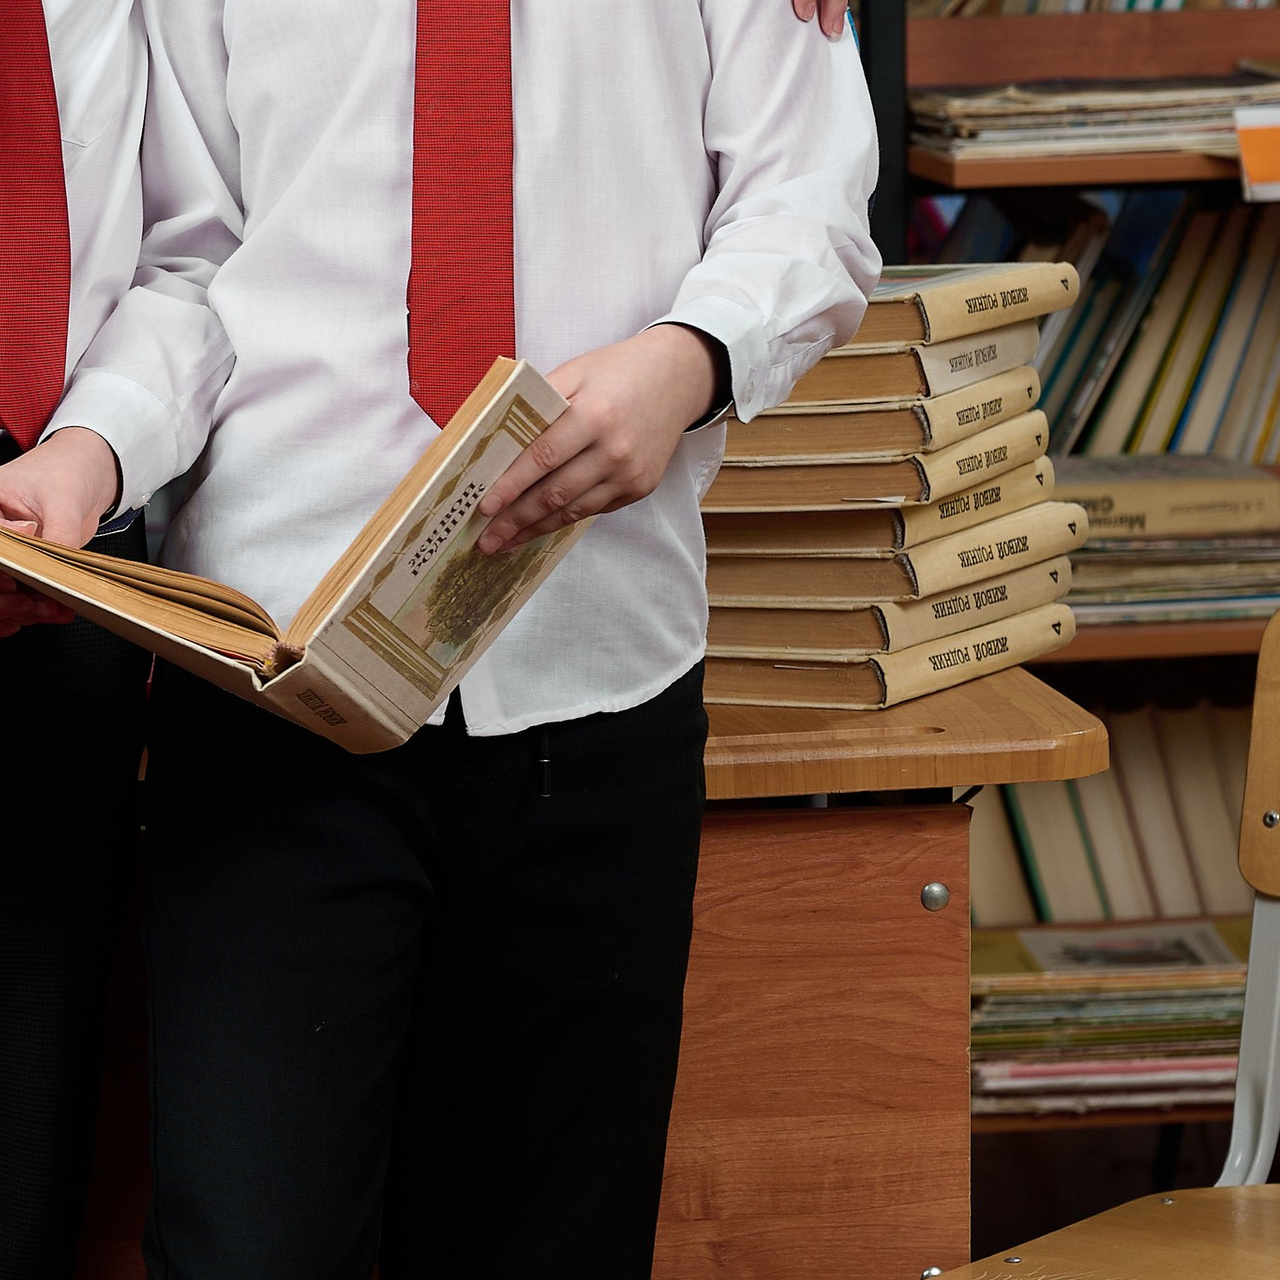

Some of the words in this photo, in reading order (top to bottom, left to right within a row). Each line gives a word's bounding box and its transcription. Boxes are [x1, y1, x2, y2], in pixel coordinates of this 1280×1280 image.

[965, 293, 998, 314] РОДНИК
[1000, 287, 1029, 309] ЖИВОЙ
[949, 351, 973, 373] РОДНИК
[974, 343, 998, 366] ЖИВОЙ
[956, 404, 980, 426] РОДНИК
[981, 397, 1003, 421] ЖИВОЙ
[956, 453, 983, 476] РОДНИК
[985, 445, 1008, 472] ЖИВОЙ
[938, 495, 970, 519] РОДНИК
[973, 486, 1001, 511] ЖИВОЙ
[408, 482, 476, 569] ЖИВОЙ
[411, 483, 487, 577] РОДНИК
[957, 545, 993, 568] РОДНИК
[995, 535, 1029, 560] ЖИВОЙ
[932, 595, 970, 619] РОДНИК
[972, 584, 1008, 610] ЖИВОЙ
[928, 646, 971, 671] РОДНИК
[972, 636, 1009, 662] ЖИВОЙ
